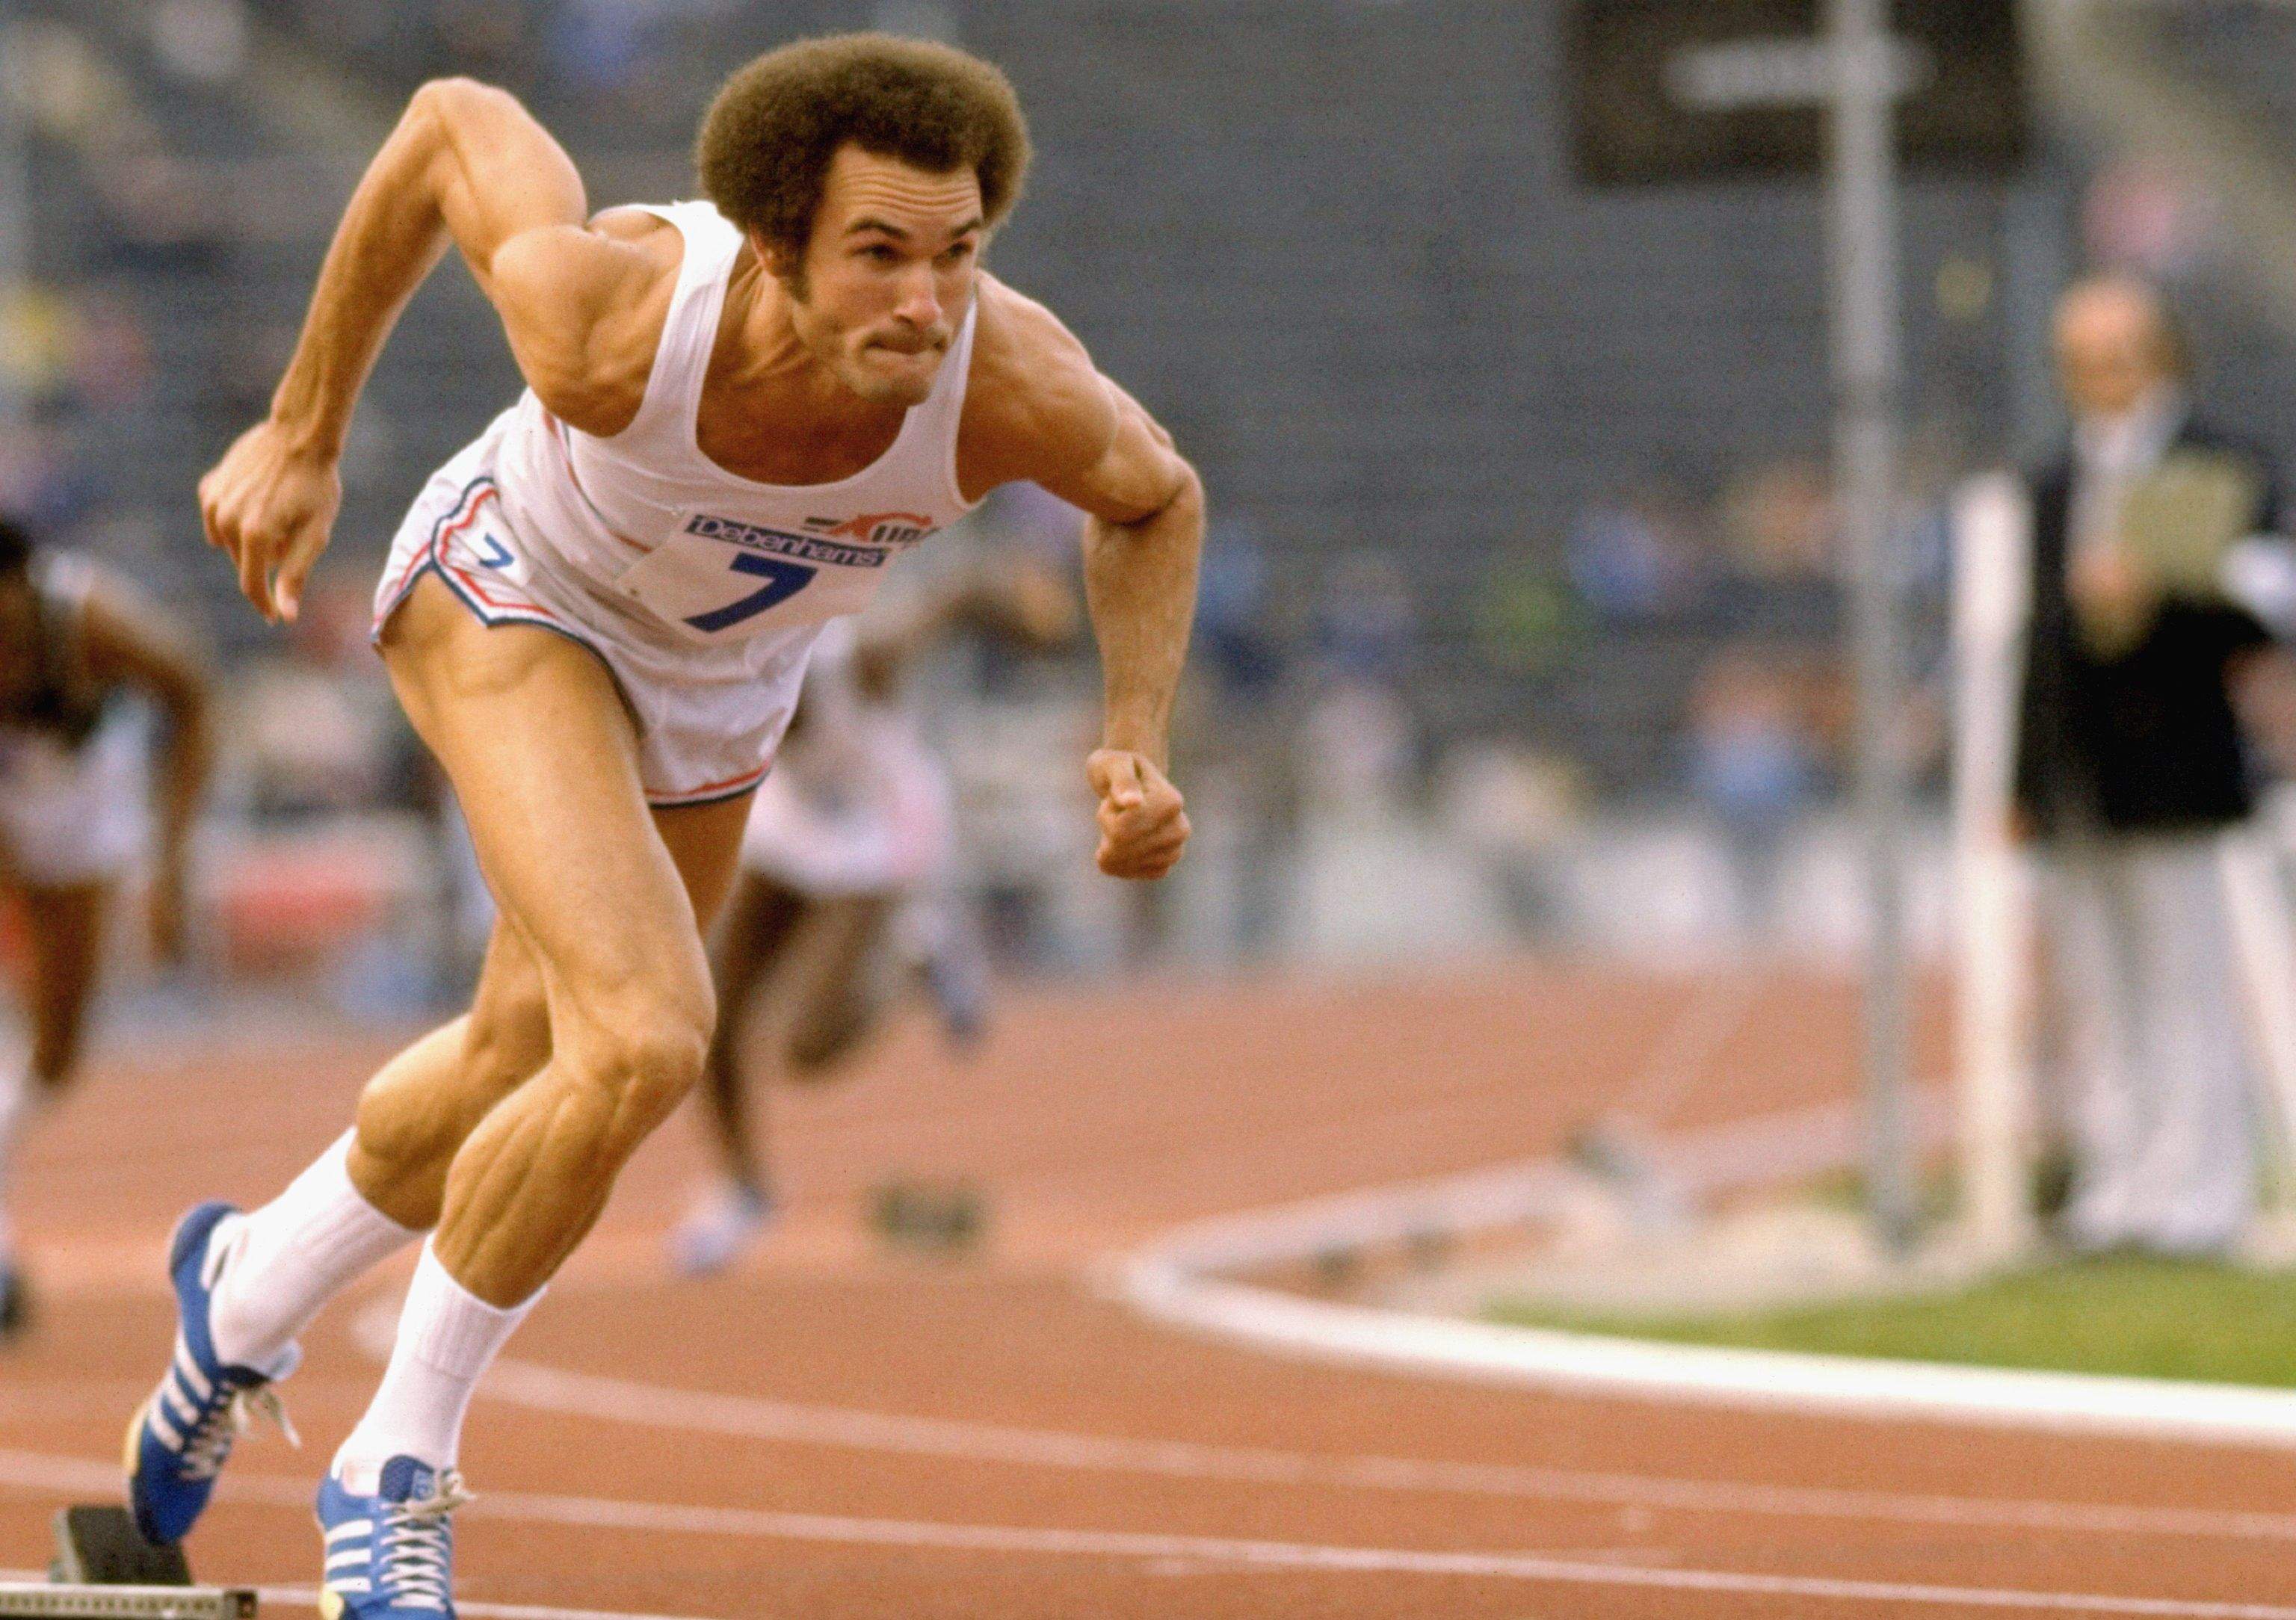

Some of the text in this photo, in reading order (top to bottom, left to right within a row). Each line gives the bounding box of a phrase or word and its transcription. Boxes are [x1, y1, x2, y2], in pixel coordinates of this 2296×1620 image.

[478, 533, 514, 569] 7
[695, 517, 880, 566] Debenhams
[682, 551, 818, 634] 7
